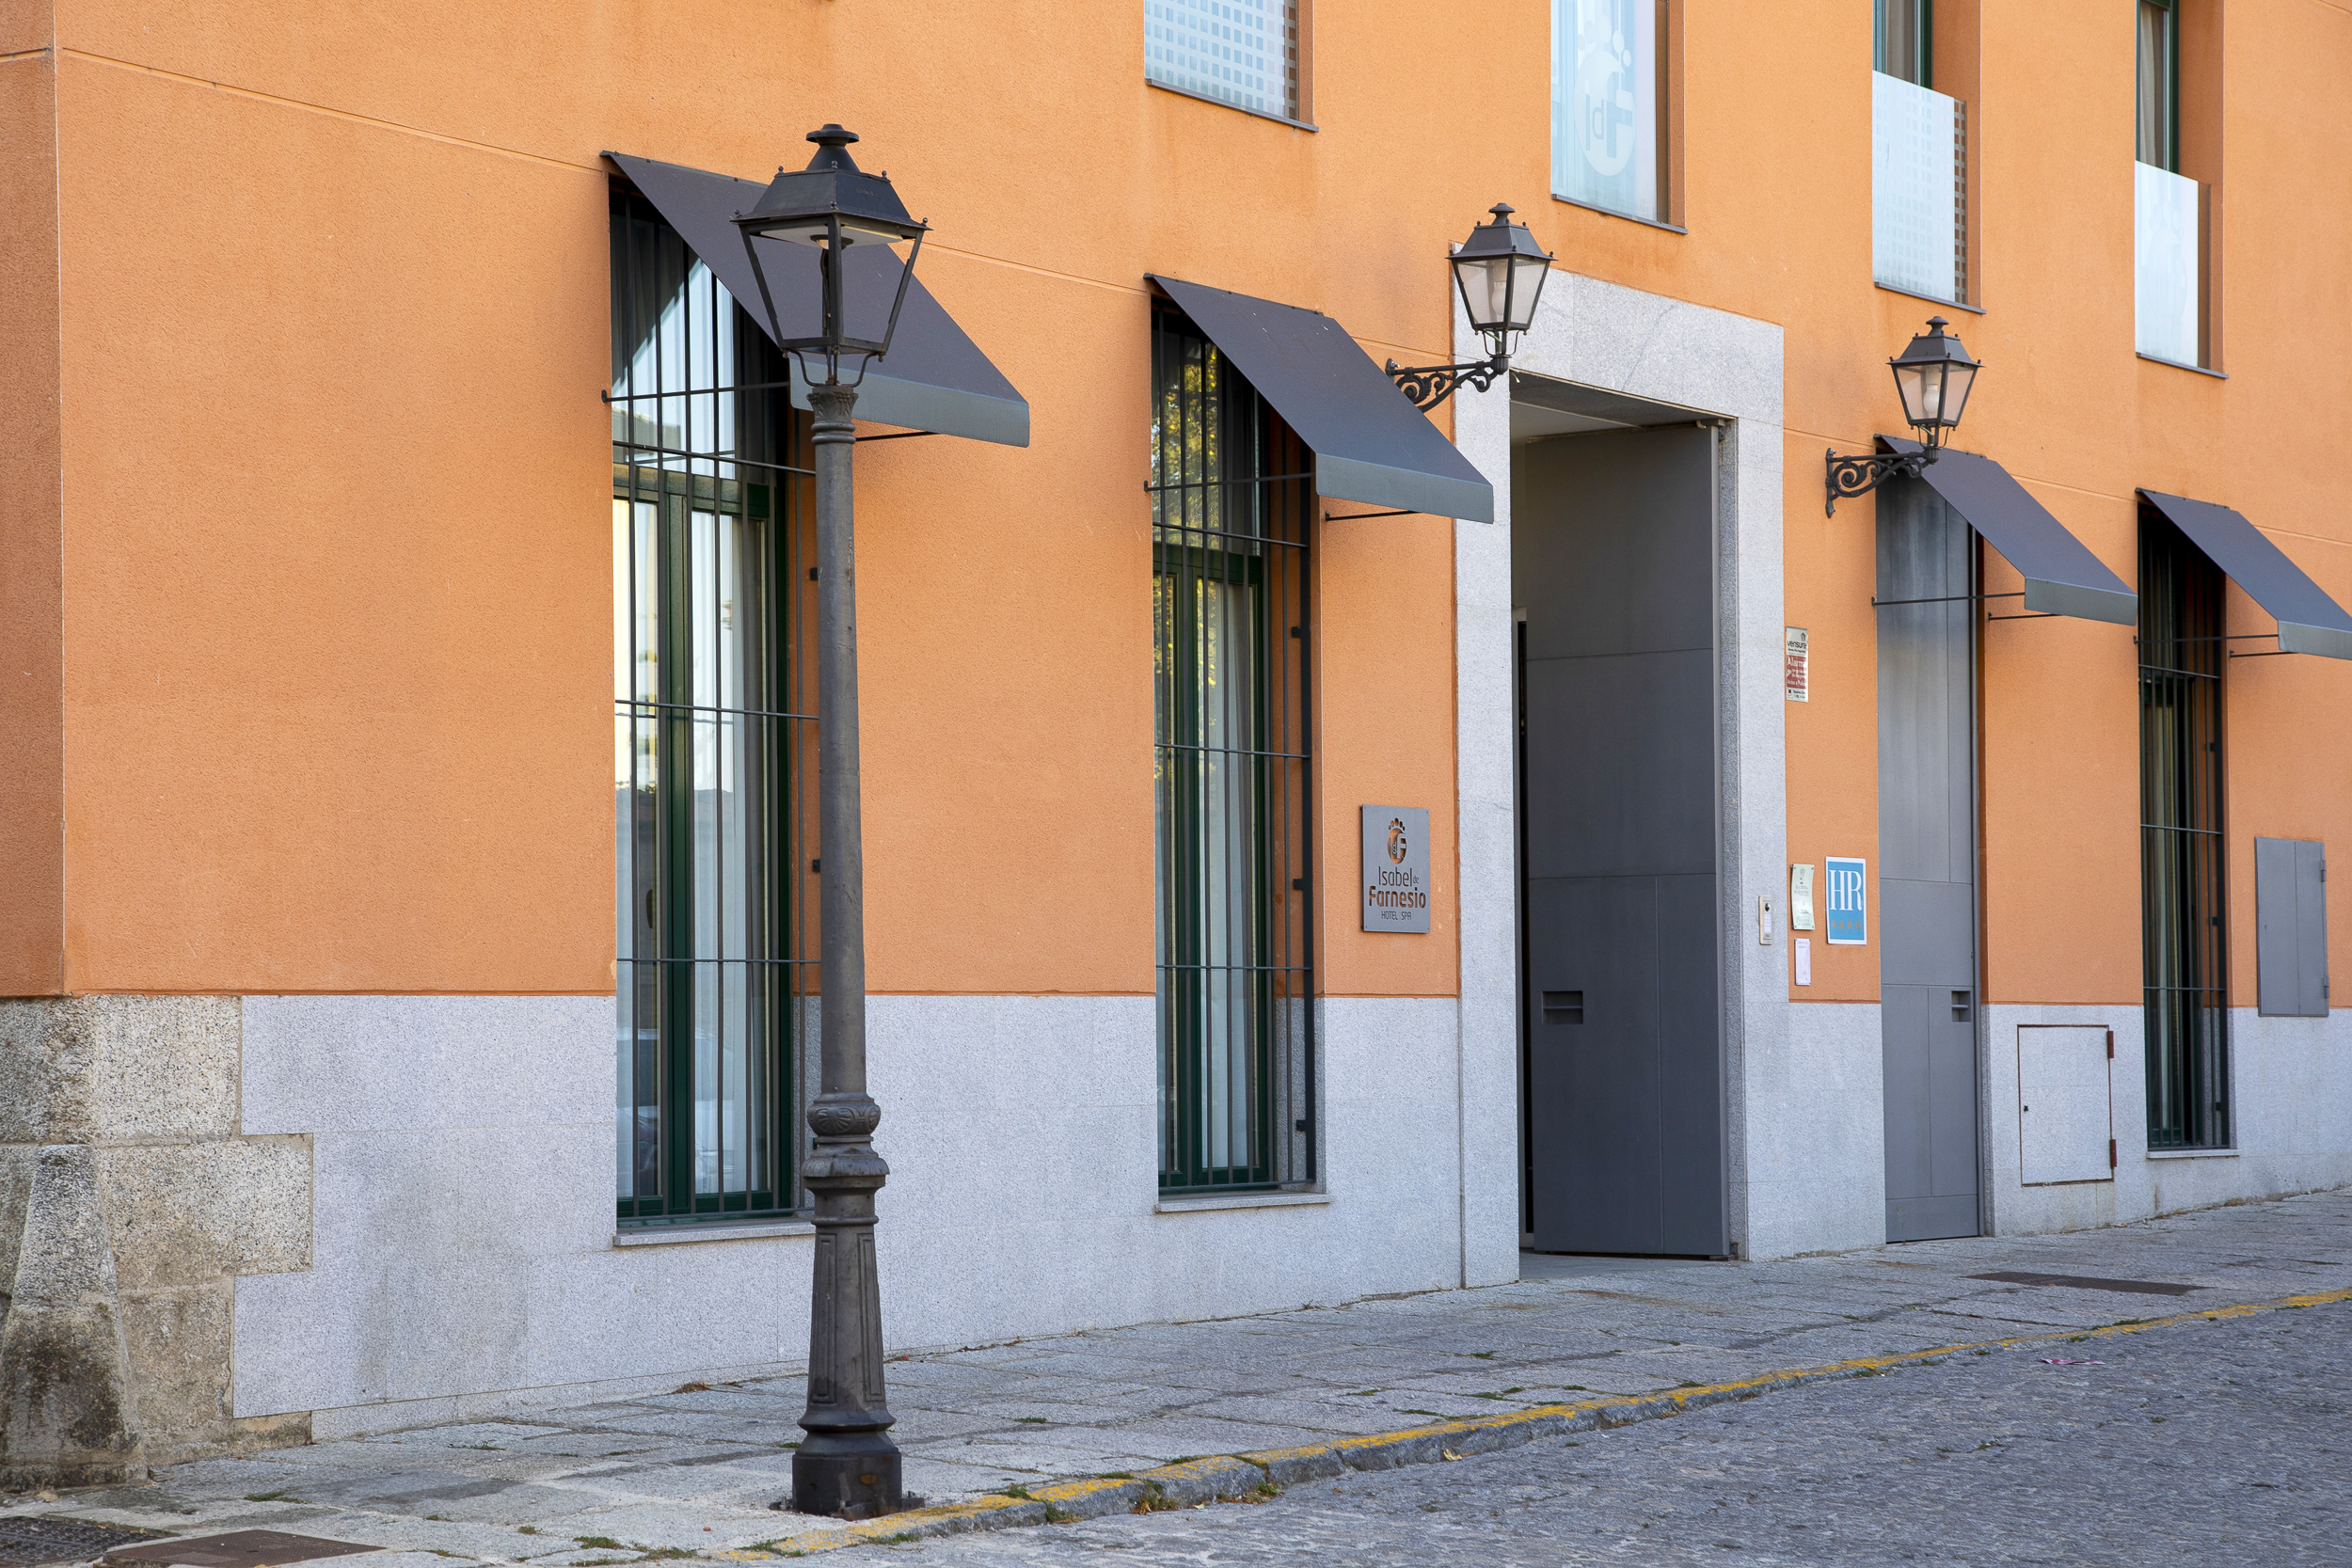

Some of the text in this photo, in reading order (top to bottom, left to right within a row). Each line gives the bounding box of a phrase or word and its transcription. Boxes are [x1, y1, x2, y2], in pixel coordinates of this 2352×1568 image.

[1378, 865, 1412, 887] Isabel
[1369, 885, 1426, 909] Farnesio
[1829, 869, 1863, 911] HR
[1381, 911, 1412, 921] HOTEL SPA
